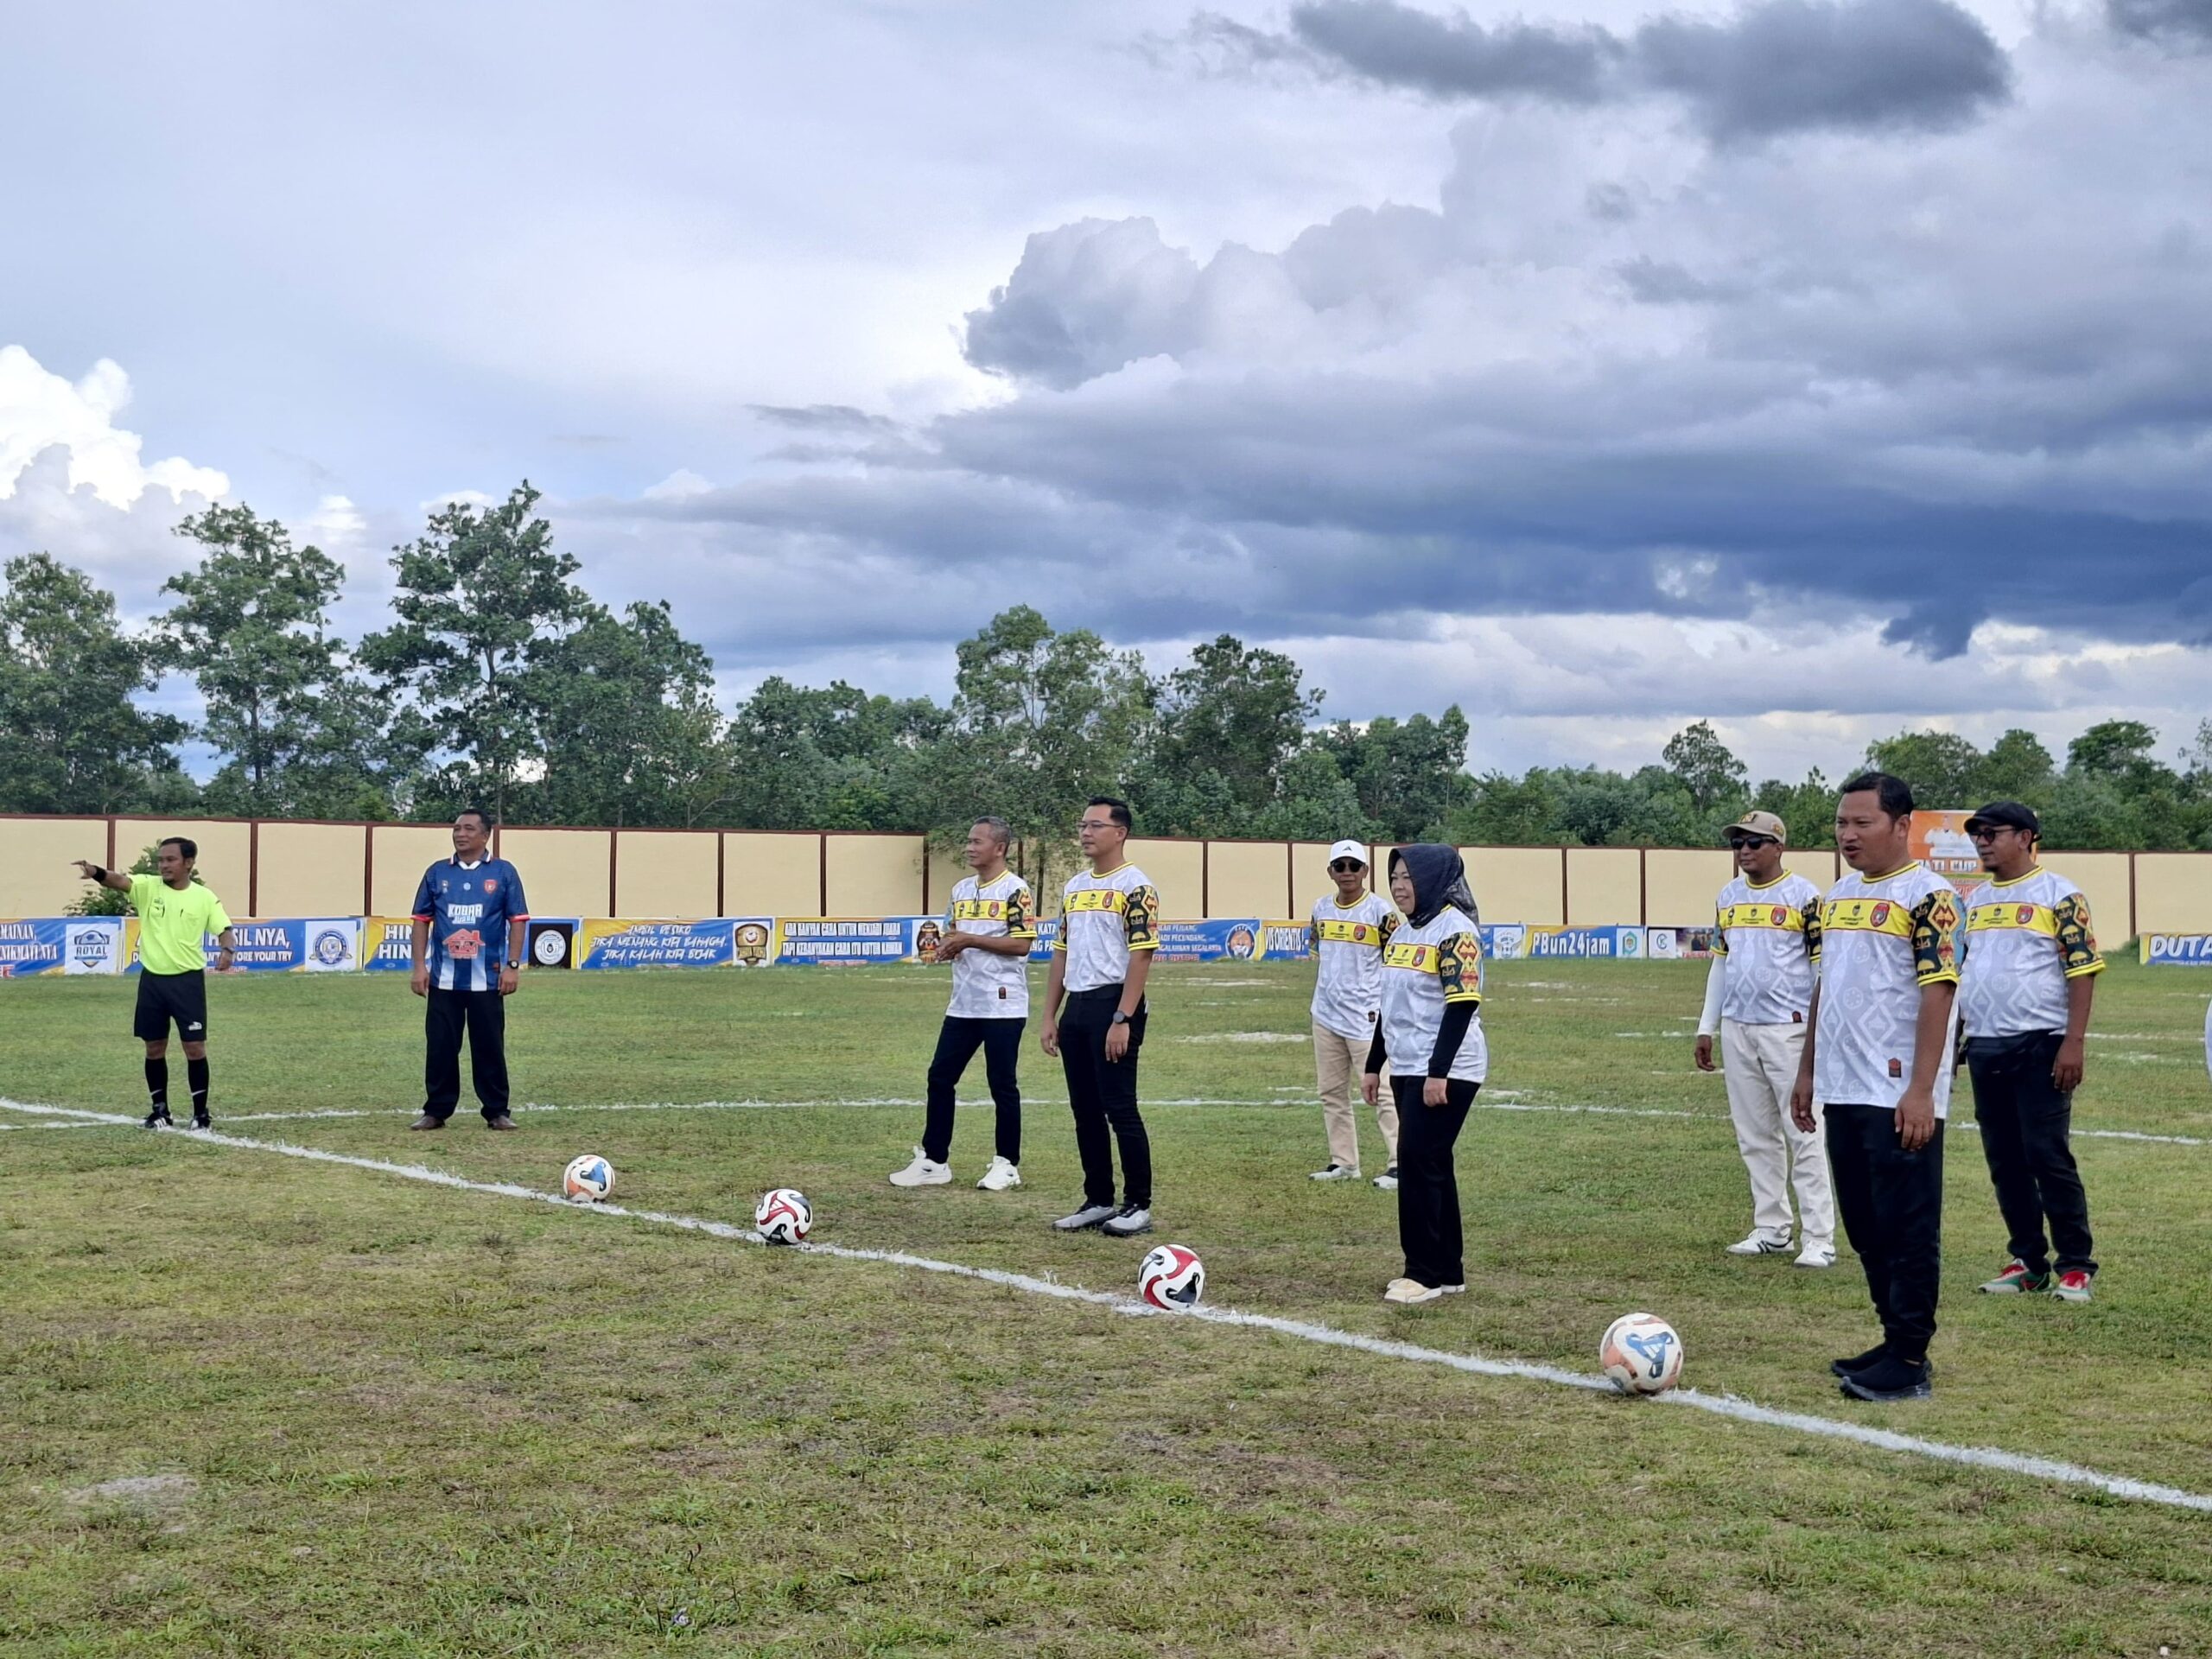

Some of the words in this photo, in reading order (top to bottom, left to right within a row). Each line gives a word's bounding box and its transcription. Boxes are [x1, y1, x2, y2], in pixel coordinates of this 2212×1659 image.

[208, 928, 251, 946] HSIL
[255, 927, 291, 949] NYA,
[1532, 931, 1610, 958] PBun24jam
[2149, 935, 2212, 957] DUTA
[76, 945, 107, 955] ROYAL
[254, 952, 276, 962] YOUR
[276, 951, 293, 962] TRY
[629, 949, 664, 961] KALAH
[665, 949, 685, 960] KITA
